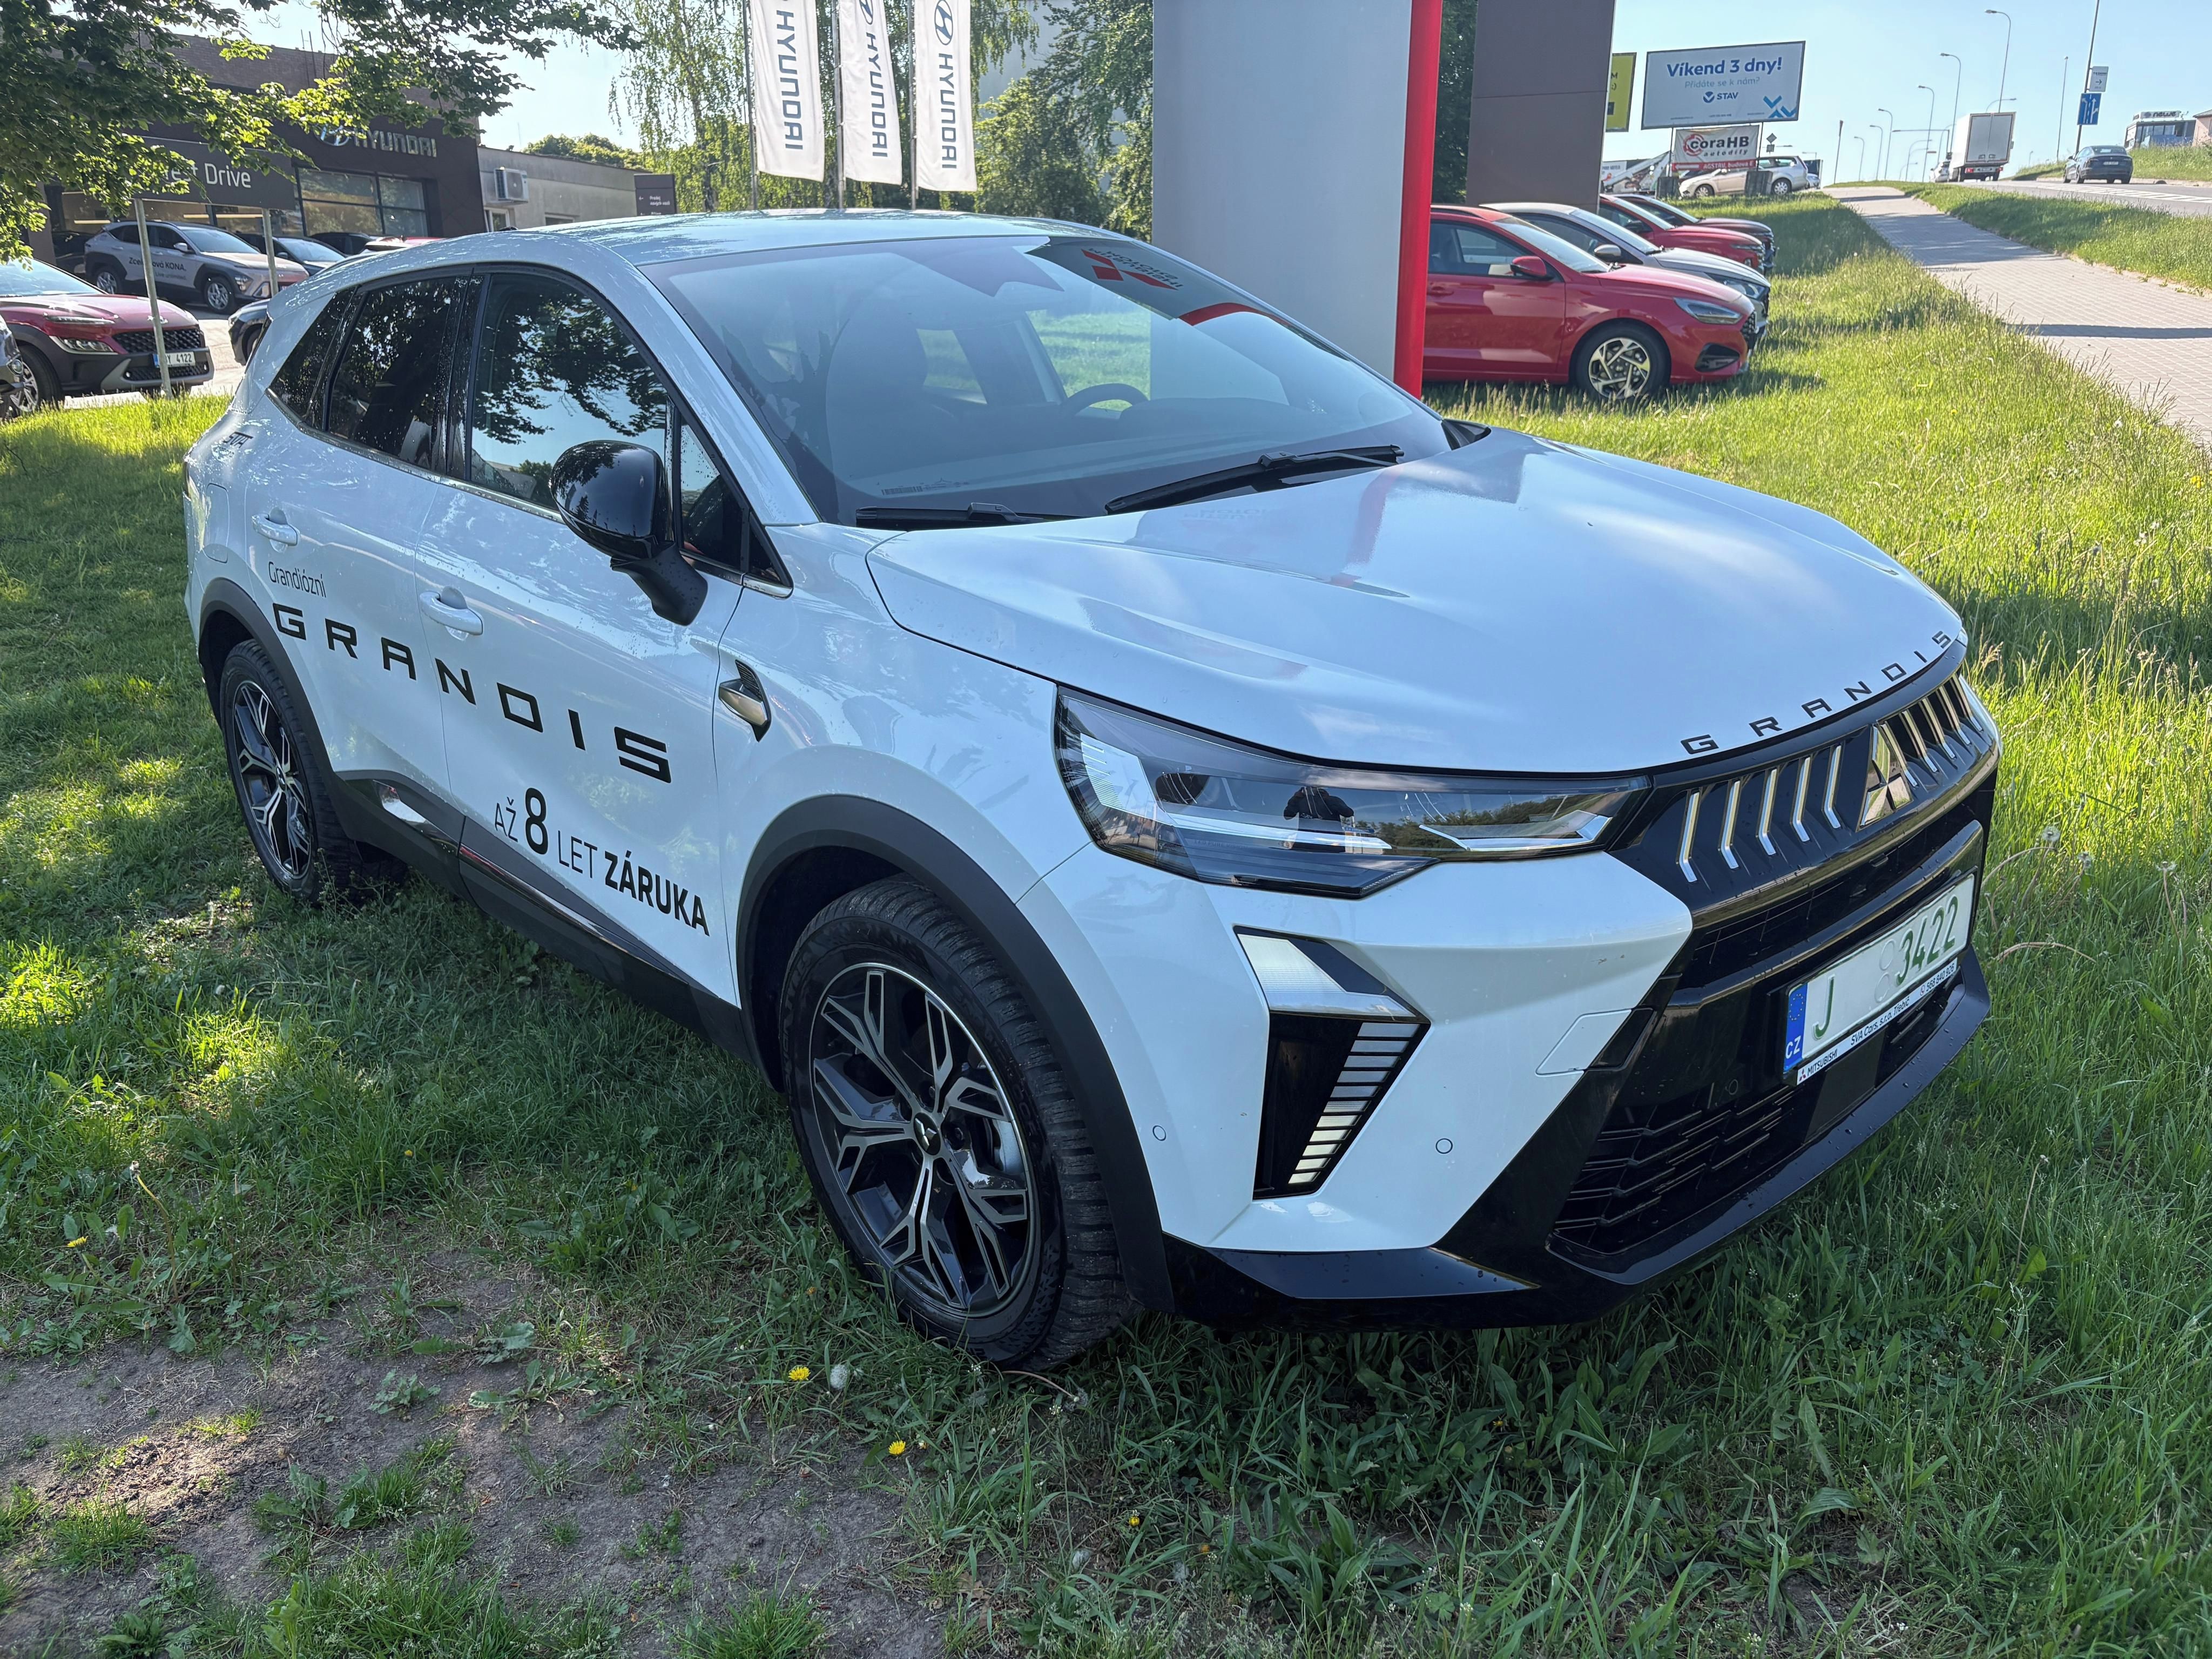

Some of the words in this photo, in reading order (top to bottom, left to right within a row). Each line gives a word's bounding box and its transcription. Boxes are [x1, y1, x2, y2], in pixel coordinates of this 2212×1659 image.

[777, 10, 803, 150] HYUNDAI
[1667, 60, 1725, 77] Víkend
[1730, 59, 1739, 73] 3
[1744, 57, 1782, 75] dny!
[866, 32, 887, 157] HYUNDAI
[1684, 80, 1715, 89] Přidáte
[1737, 77, 1760, 85] nám?
[1717, 92, 1739, 100] STAV
[939, 53, 957, 169] HYUNDAI
[354, 127, 437, 157] HYUNDAI
[1690, 136, 1749, 149] coraHB
[162, 161, 198, 183] et
[205, 163, 251, 188] Drive
[129, 257, 144, 265] Zcel
[177, 353, 192, 363] 4122
[222, 431, 254, 449] SVA
[268, 561, 326, 598] Grandiózní
[272, 603, 671, 784] GRANDIS
[1680, 630, 1952, 755] GRANDIS
[495, 797, 518, 842] AŽ
[525, 788, 549, 855] 8
[558, 830, 598, 879] LET
[604, 851, 710, 937] ZÁRUKA
[1812, 973, 1835, 1040] J
[1896, 894, 1959, 986] 3422
[1808, 1049, 1838, 1076] MITSUBISHI
[1851, 1030, 1863, 1046] SVA
[1879, 1013, 1892, 1026] s.r.o.
[1893, 996, 1910, 1017] Třebíč
[1926, 978, 1936, 992] 568
[1936, 970, 1945, 984] 840
[1946, 963, 1954, 976] 926
[1785, 1035, 1801, 1060] CZ
